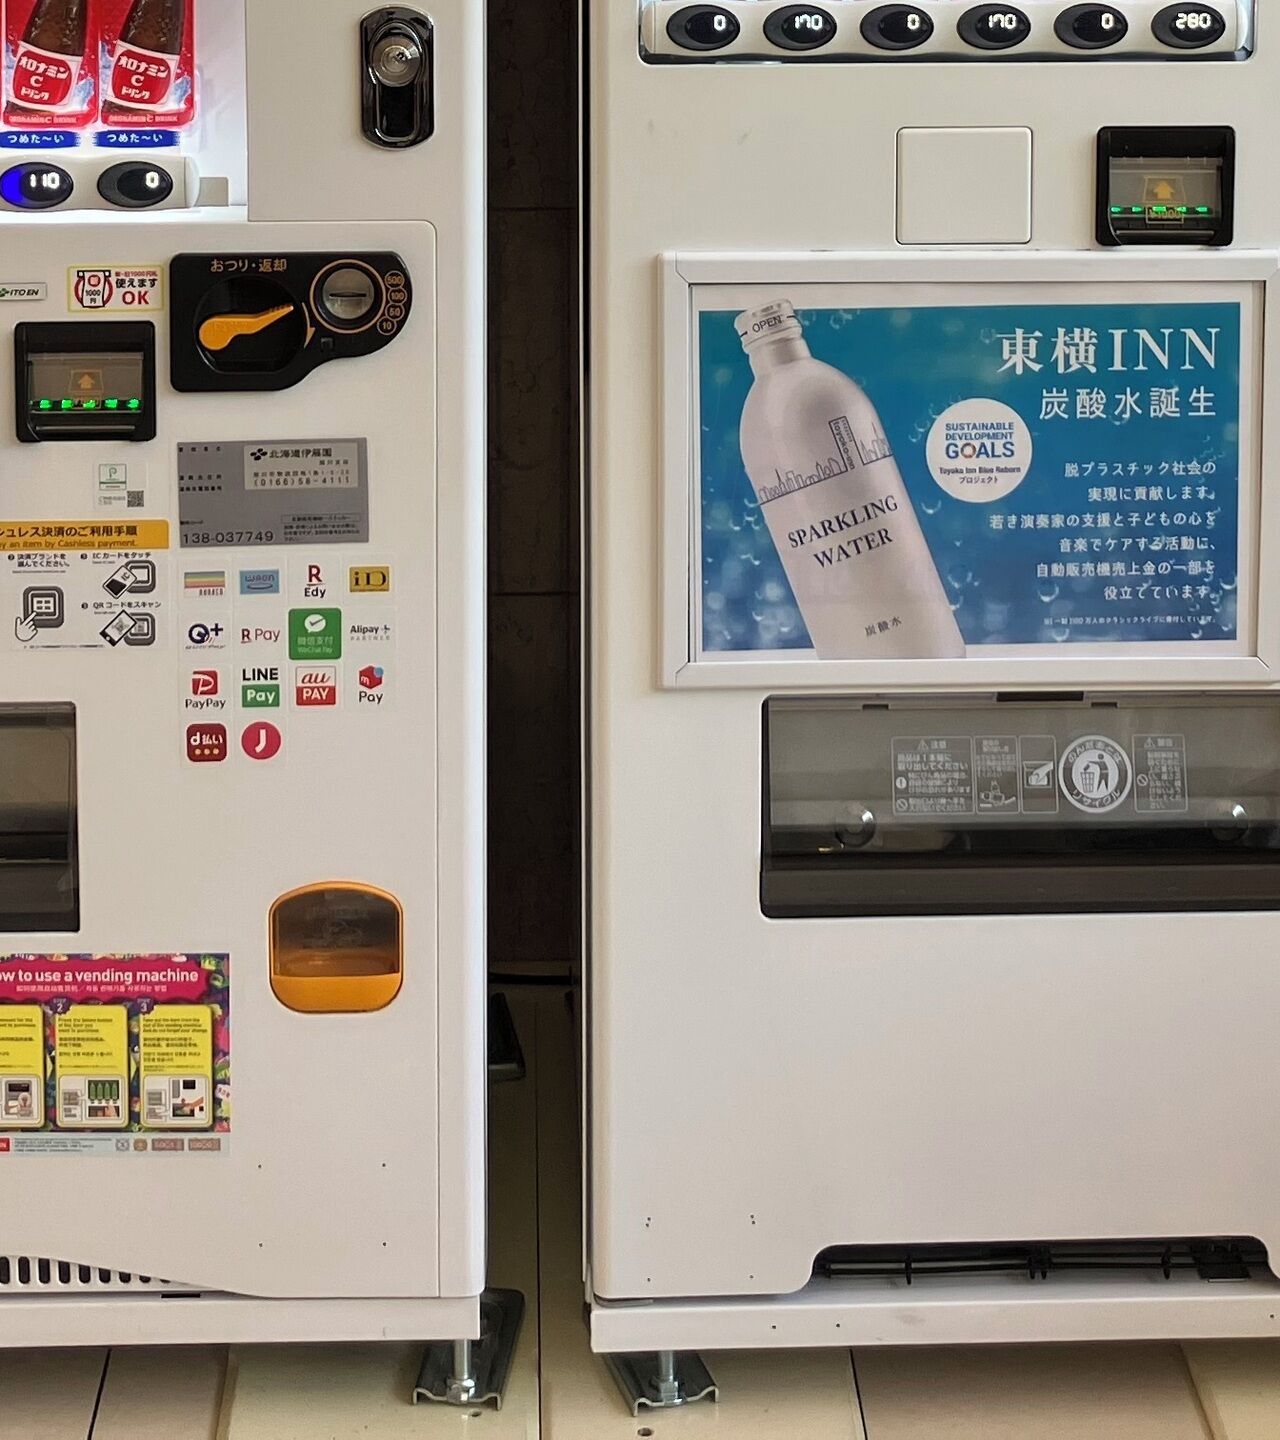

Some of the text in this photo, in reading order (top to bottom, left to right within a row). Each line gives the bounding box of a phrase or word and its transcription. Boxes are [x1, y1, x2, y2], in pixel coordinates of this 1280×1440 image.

[1175, 12, 1211, 29] 280
[118, 56, 170, 78] オロナミン
[115, 277, 158, 289] 使えます
[122, 290, 150, 305] OK
[751, 313, 784, 334] OPEN
[995, 325, 1221, 376] 東横INN
[1038, 386, 1218, 420] 炭酸水誕生
[945, 421, 1015, 431] SUSTAINABLE
[945, 431, 1014, 441] DEVELOPMENT
[945, 441, 1015, 460] GOALS
[1064, 460, 1217, 478] 脱プラスチック社会の
[1088, 485, 1217, 502] 実現に貢献します。
[786, 494, 899, 552] SPARKLING
[183, 531, 274, 545] 138-037749
[813, 526, 894, 571] WATER
[304, 586, 327, 599] Edy
[350, 624, 379, 635] Alipay
[242, 668, 279, 681] LINE
[246, 689, 276, 704] Pay
[302, 687, 330, 701] PAY
[359, 690, 384, 705] Pay
[185, 698, 227, 709] PayPay
[1073, 789, 1121, 806] リサイクル
[18, 969, 33, 982] to
[35, 971, 62, 982] use
[64, 971, 74, 982] a
[76, 968, 134, 985] vending
[136, 968, 199, 982] machine
